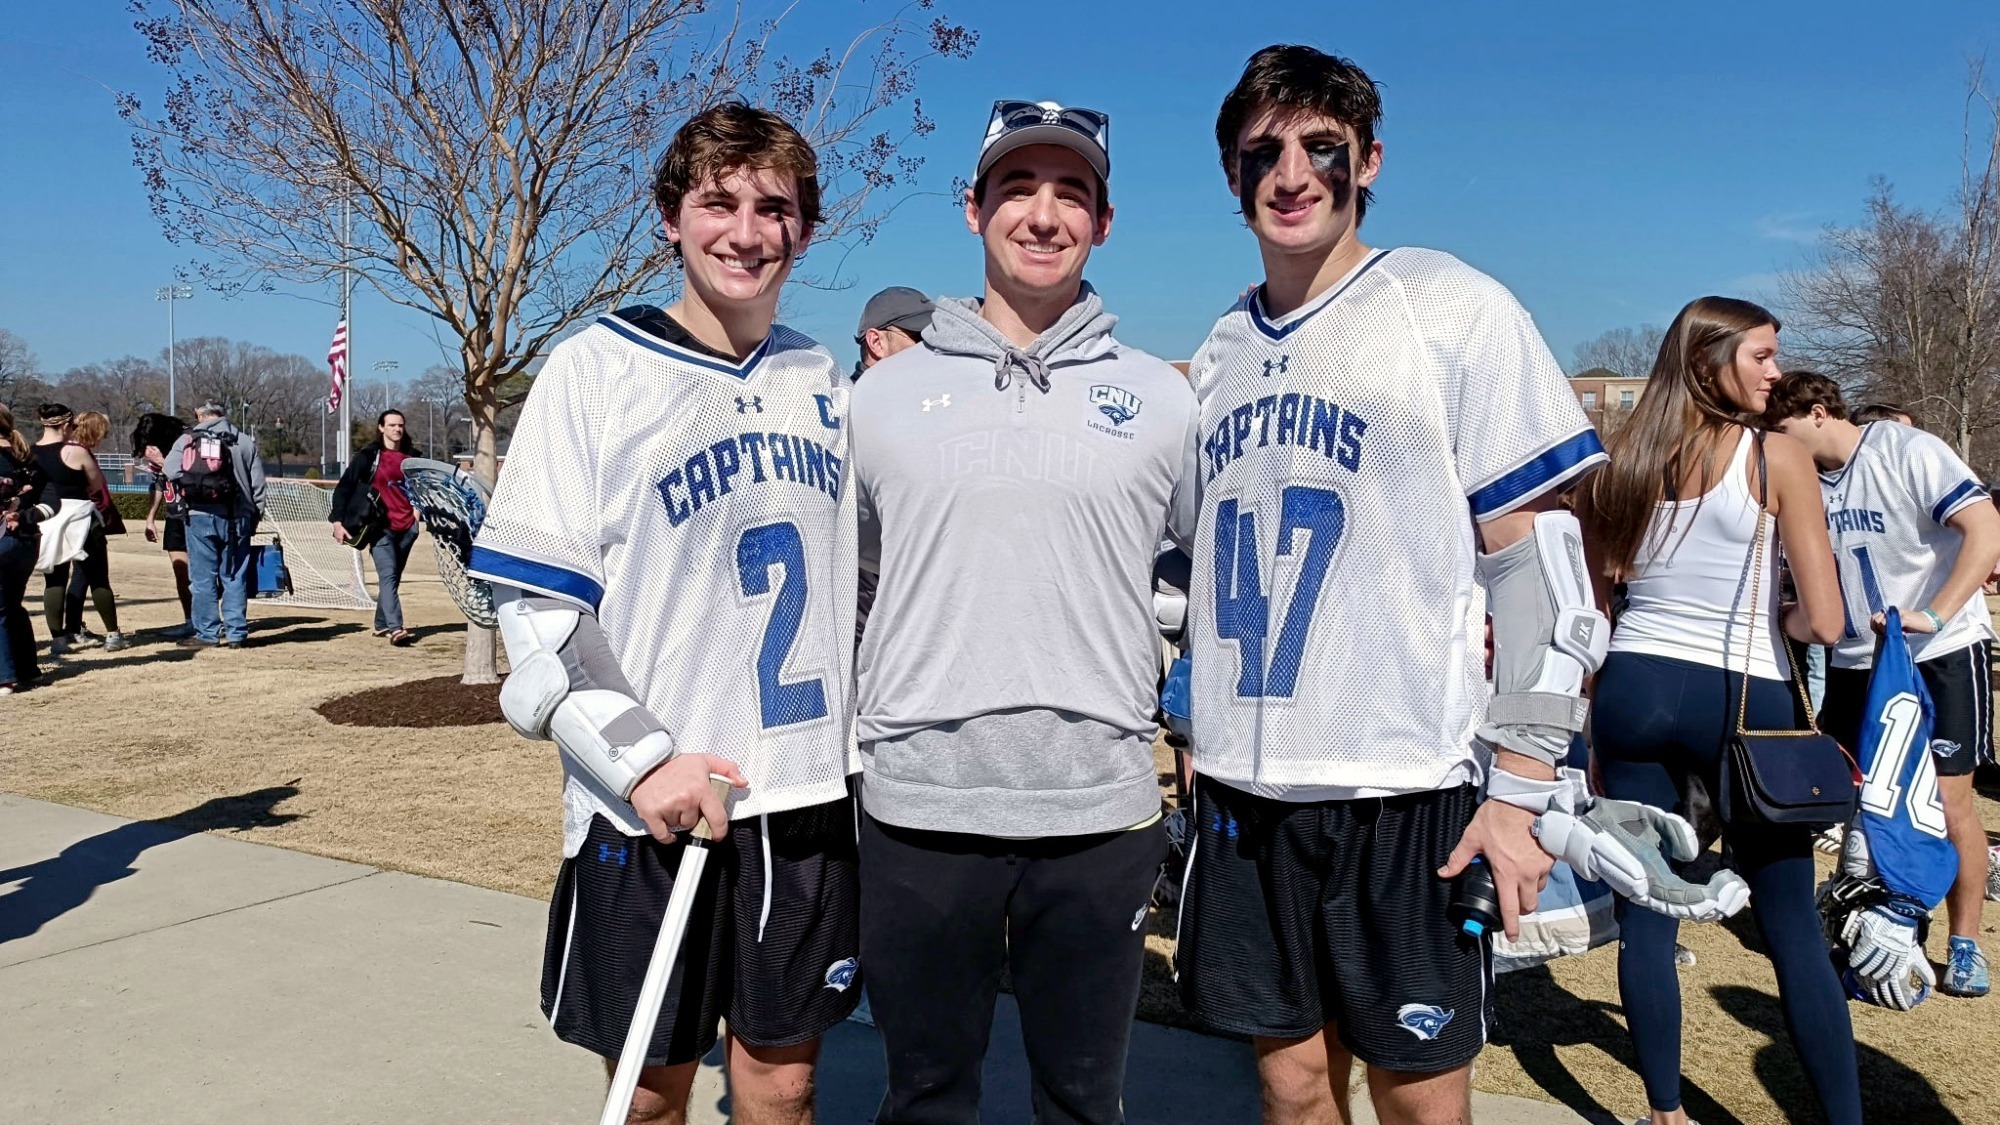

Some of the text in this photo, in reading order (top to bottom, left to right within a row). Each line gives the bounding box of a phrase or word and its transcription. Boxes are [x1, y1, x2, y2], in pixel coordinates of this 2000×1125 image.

[813, 394, 840, 429] C
[1089, 385, 1142, 414] CNU
[656, 432, 842, 528] CAPTAINS
[938, 428, 1098, 492] CNU
[1825, 508, 1886, 534] TAINS
[736, 521, 828, 729] 2
[1214, 486, 1345, 698] 47
[1834, 545, 1886, 639] 1
